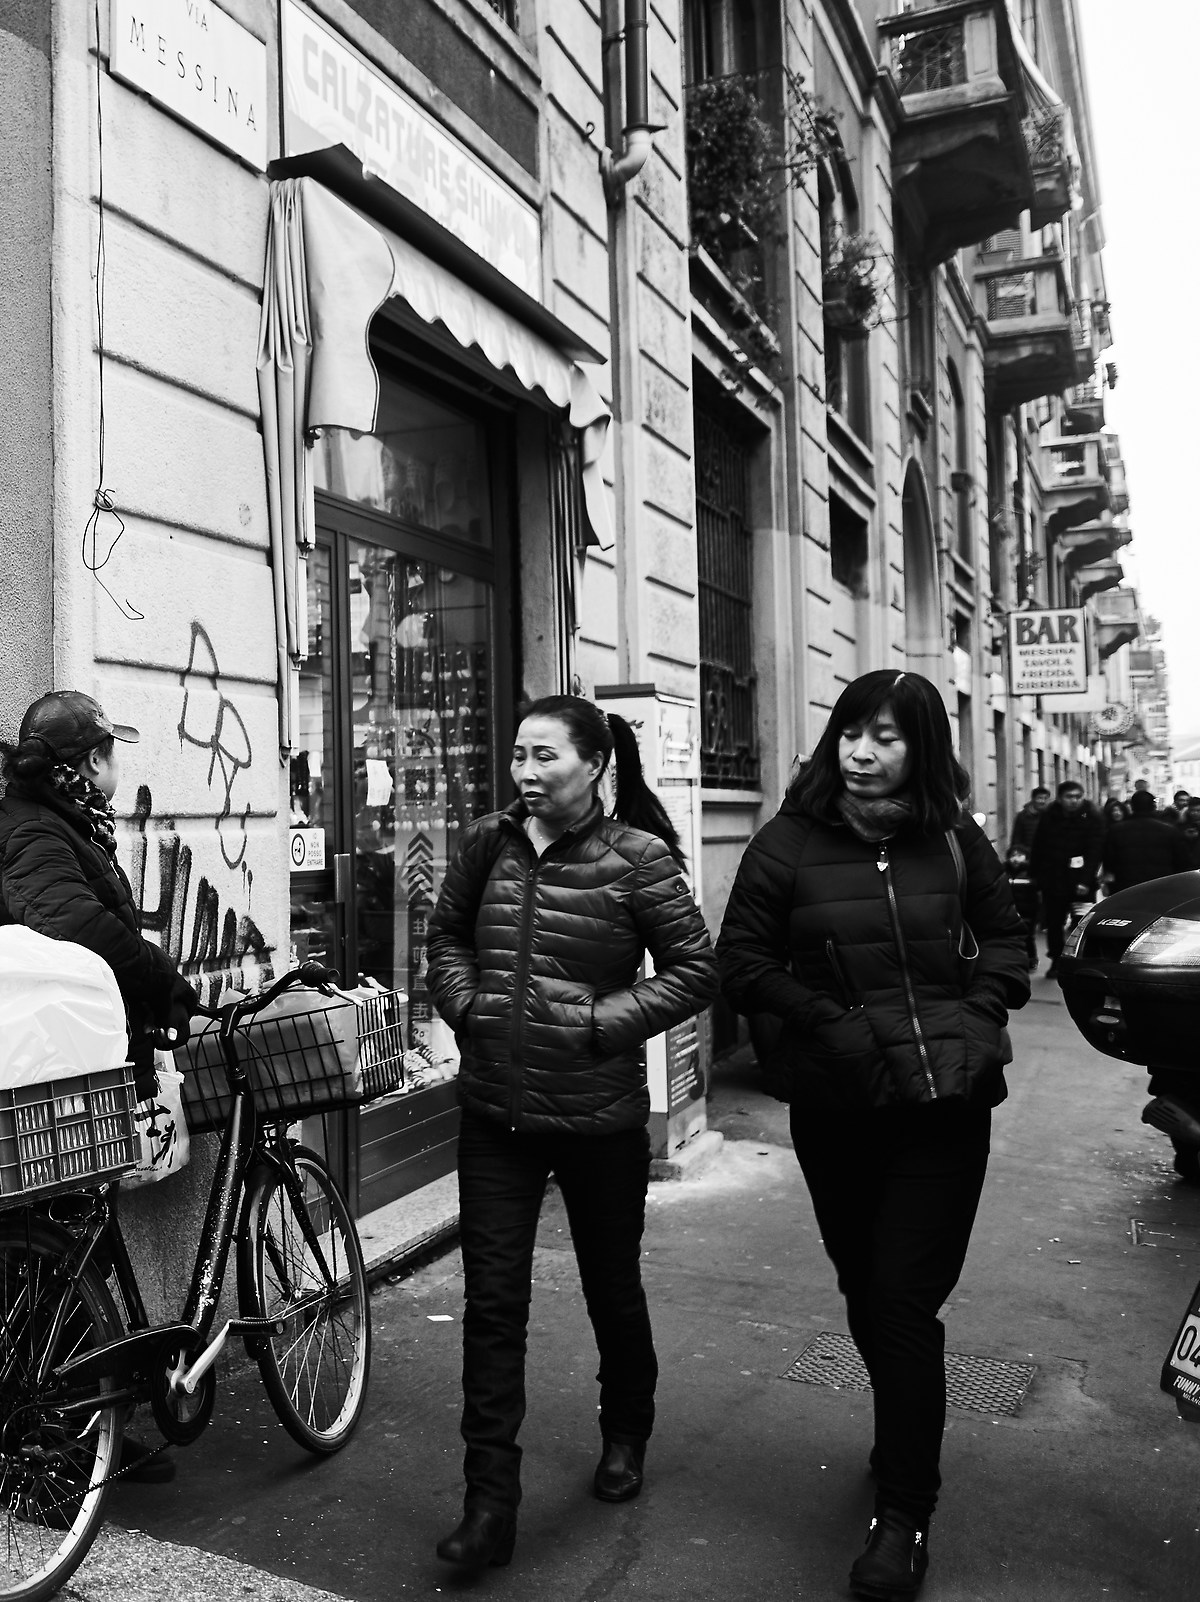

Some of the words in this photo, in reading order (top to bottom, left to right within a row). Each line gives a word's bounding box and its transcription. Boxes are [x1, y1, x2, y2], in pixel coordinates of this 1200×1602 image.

[186, 0, 208, 32] VIA
[129, 15, 257, 132] MESSINA
[302, 33, 452, 198] CALZATURE
[1016, 615, 1080, 646] BAR
[1173, 1375, 1200, 1395] FUNNY
